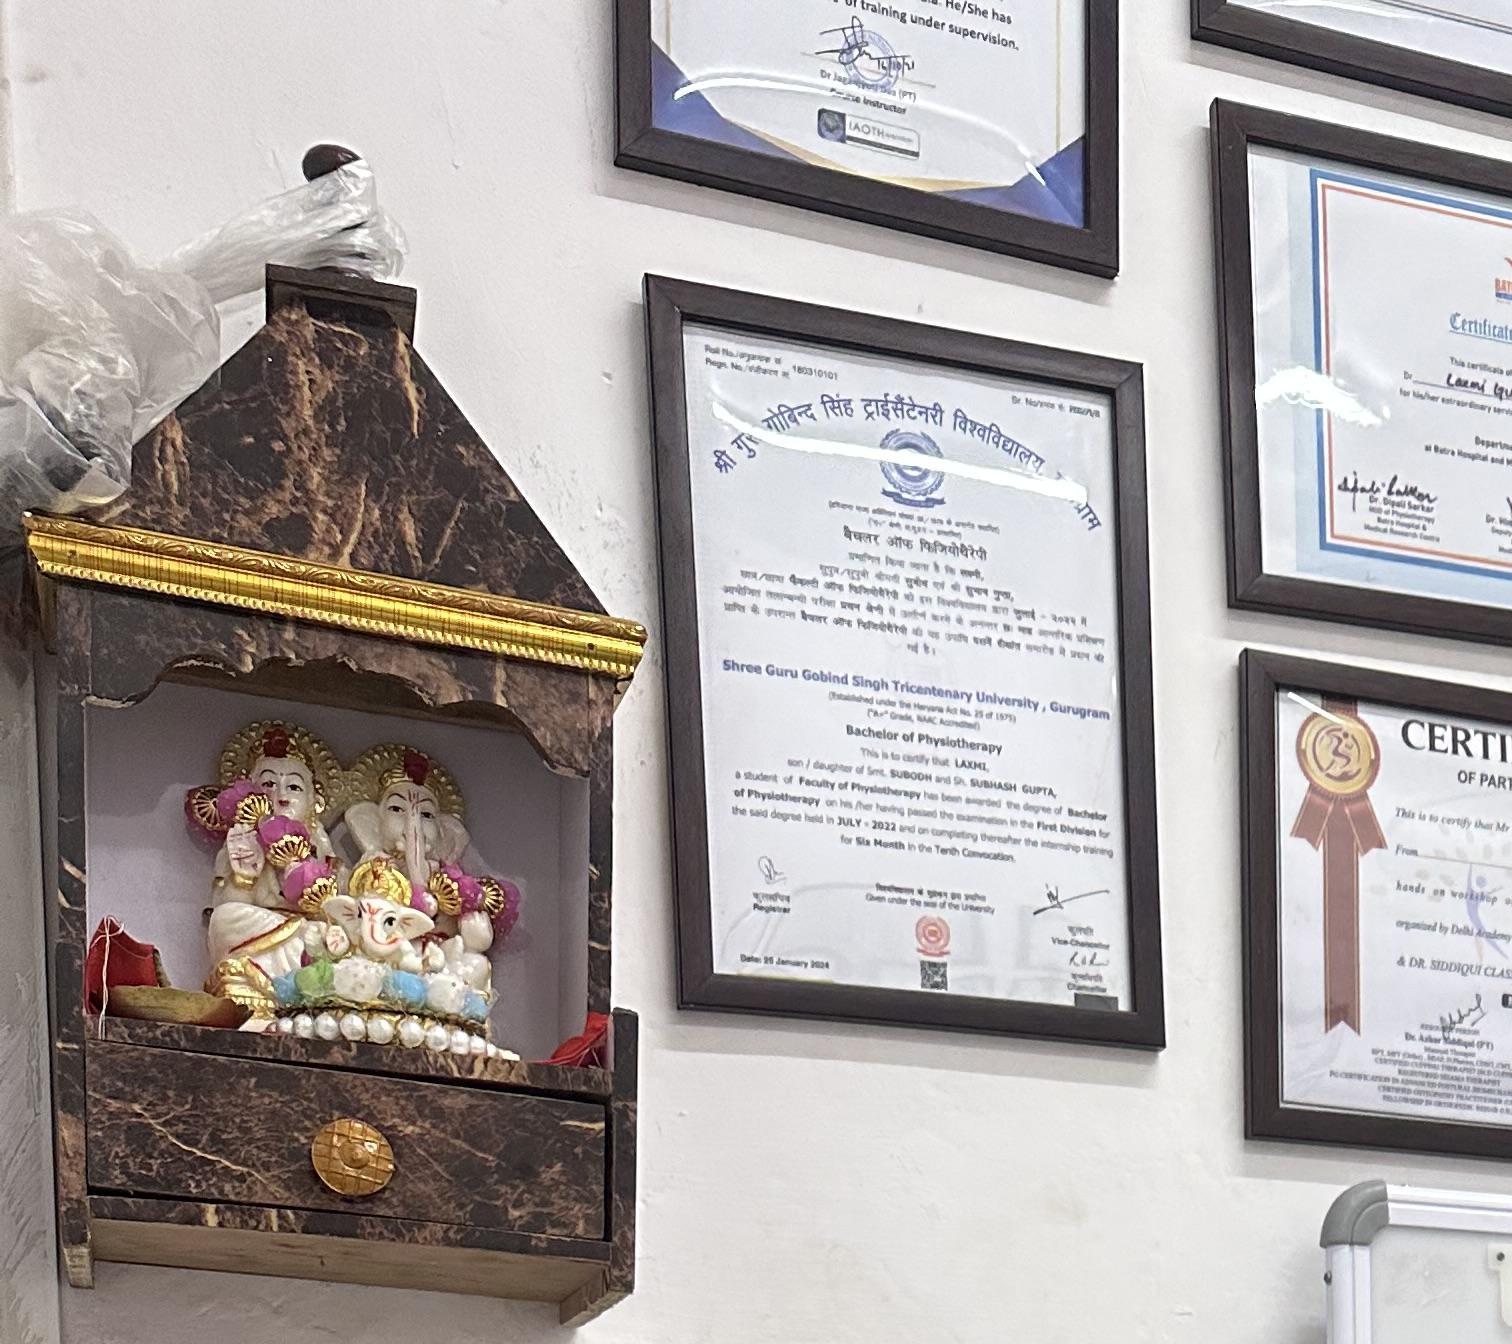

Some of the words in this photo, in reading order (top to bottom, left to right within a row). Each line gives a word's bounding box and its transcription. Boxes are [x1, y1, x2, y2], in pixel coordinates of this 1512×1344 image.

[946, 0, 988, 18] He/She
[992, 8, 1012, 23] has
[862, 1, 907, 24] training
[911, 14, 946, 31] under
[949, 25, 1019, 50] supervision.
[713, 449, 737, 473] श्री
[761, 403, 817, 433] गोबिन्द
[820, 393, 854, 419] सिंह
[952, 408, 1046, 473] विश्वविद्यालय
[722, 658, 762, 674] Shree
[765, 664, 798, 679] Guru
[802, 669, 848, 685] Gobind
[852, 675, 889, 692] Singh
[893, 680, 972, 703] Tricentenary
[976, 691, 1039, 711] University
[1050, 701, 1110, 720] Gurugram
[846, 724, 899, 740] Bachelor
[902, 731, 914, 743] of
[918, 733, 1002, 756] Physiotherapy
[1458, 770, 1476, 784] OF
[1396, 807, 1415, 819] This
[1418, 811, 1426, 821] is
[1429, 814, 1439, 823] to
[1441, 817, 1472, 829] certify
[1474, 819, 1493, 830] that
[1496, 821, 1510, 832] Mr
[1396, 880, 1425, 894] hands
[1396, 956, 1405, 967] &
[1430, 960, 1482, 976] SIDDIQUI
